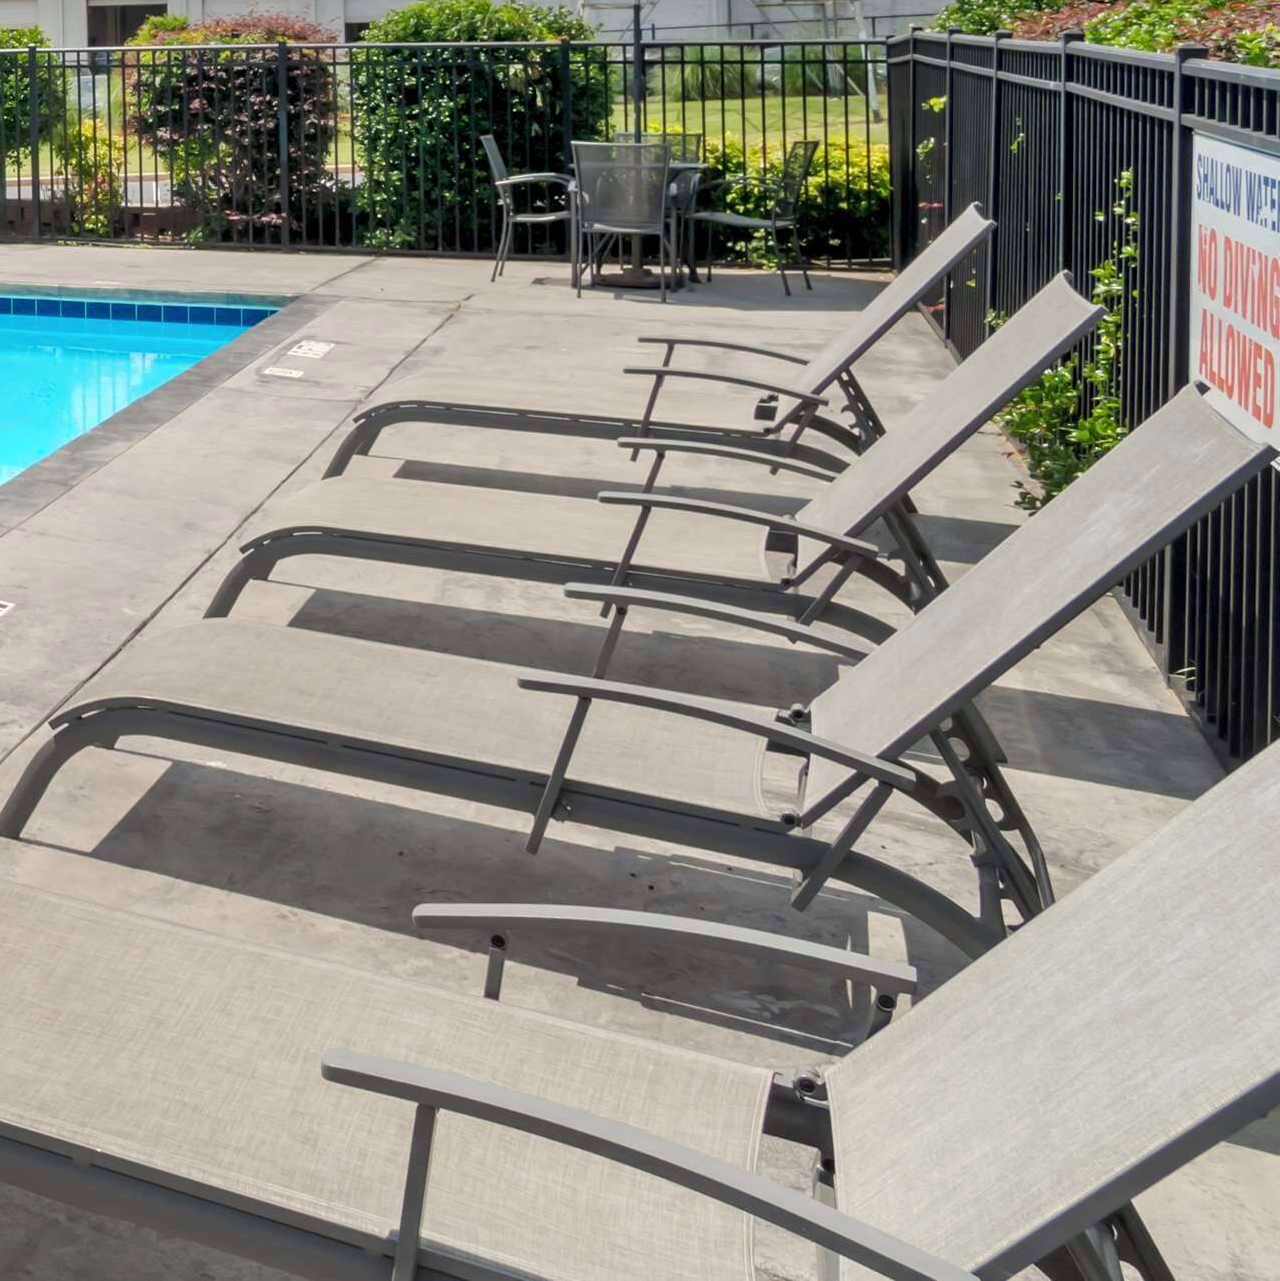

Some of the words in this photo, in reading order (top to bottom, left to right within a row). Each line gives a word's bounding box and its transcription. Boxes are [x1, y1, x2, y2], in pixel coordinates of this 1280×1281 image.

[1197, 153, 1242, 217] SHALLOW
[1244, 169, 1280, 234] WATE
[1198, 222, 1217, 301] NO
[1199, 308, 1275, 429] ALLOWED
